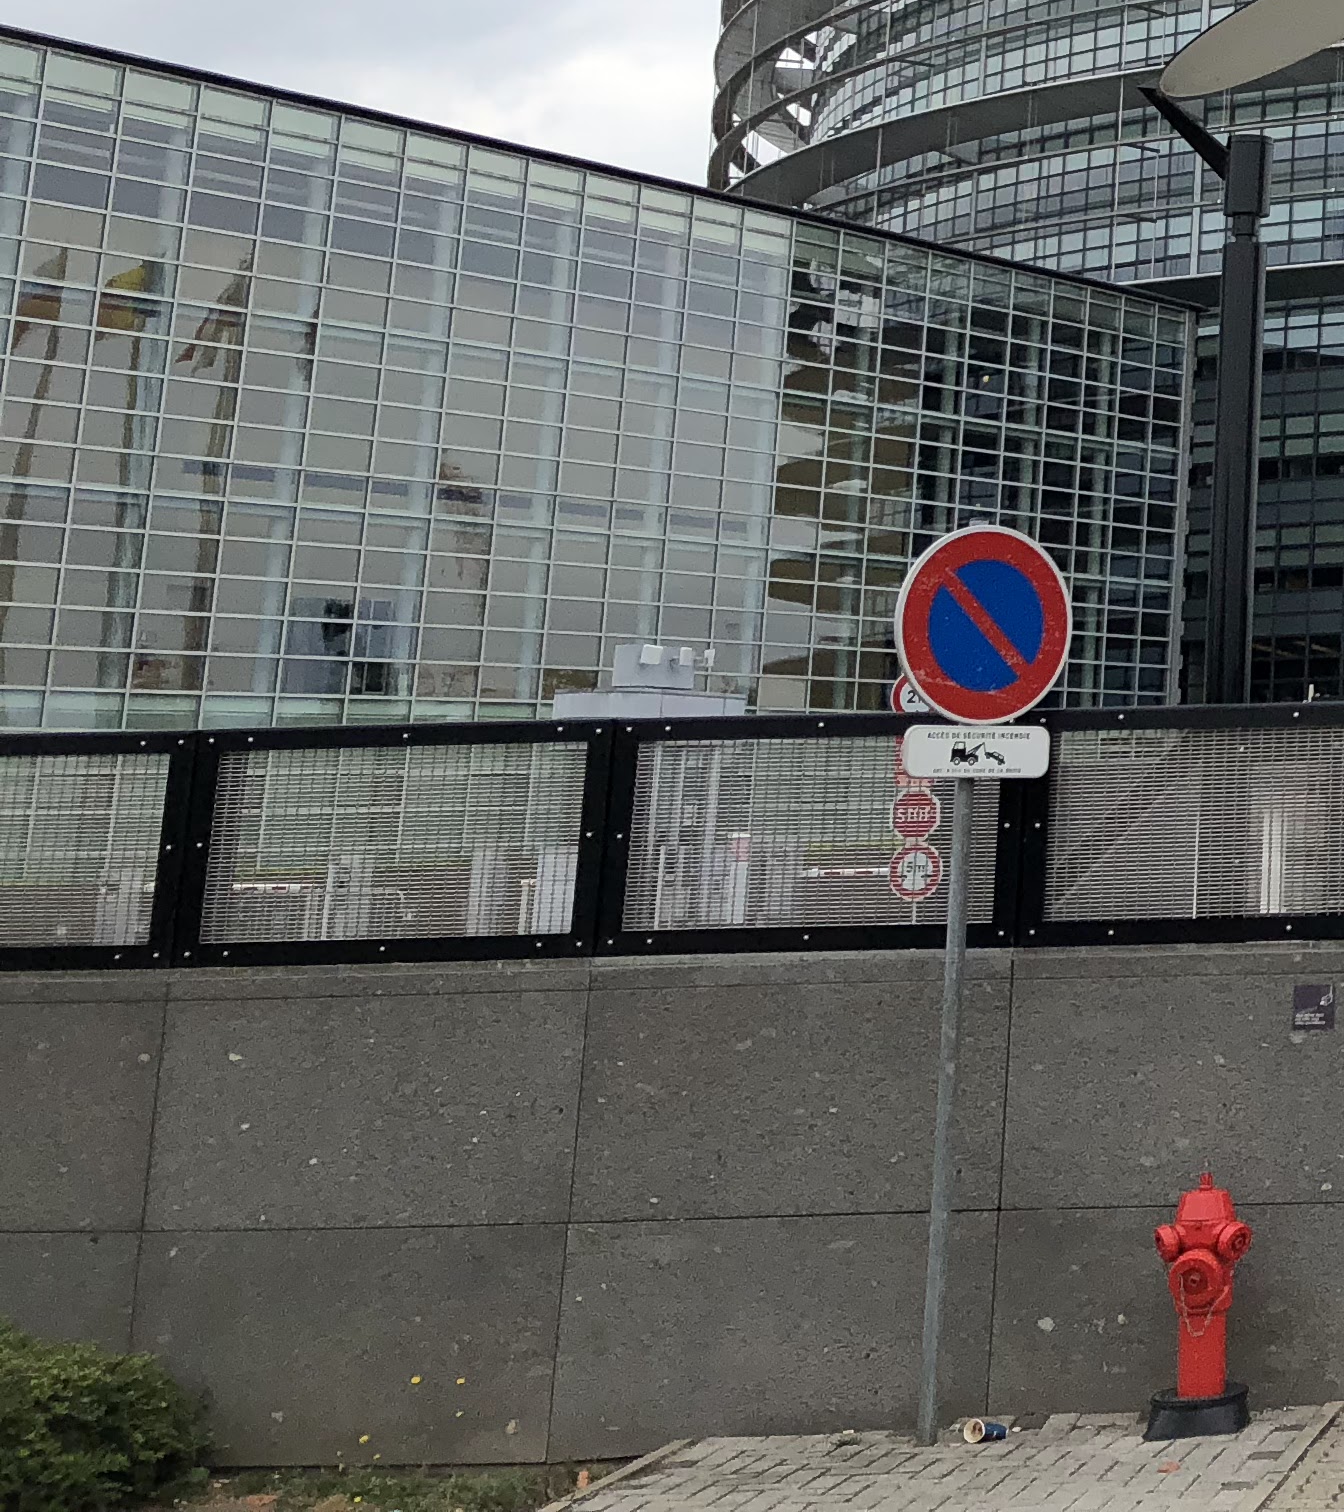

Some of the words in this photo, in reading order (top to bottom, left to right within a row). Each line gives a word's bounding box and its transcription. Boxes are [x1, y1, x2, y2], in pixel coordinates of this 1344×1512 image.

[927, 731, 950, 739] ACCÈS
[963, 731, 996, 740] SÉCURITÉ
[998, 732, 1031, 740] INCENDIE
